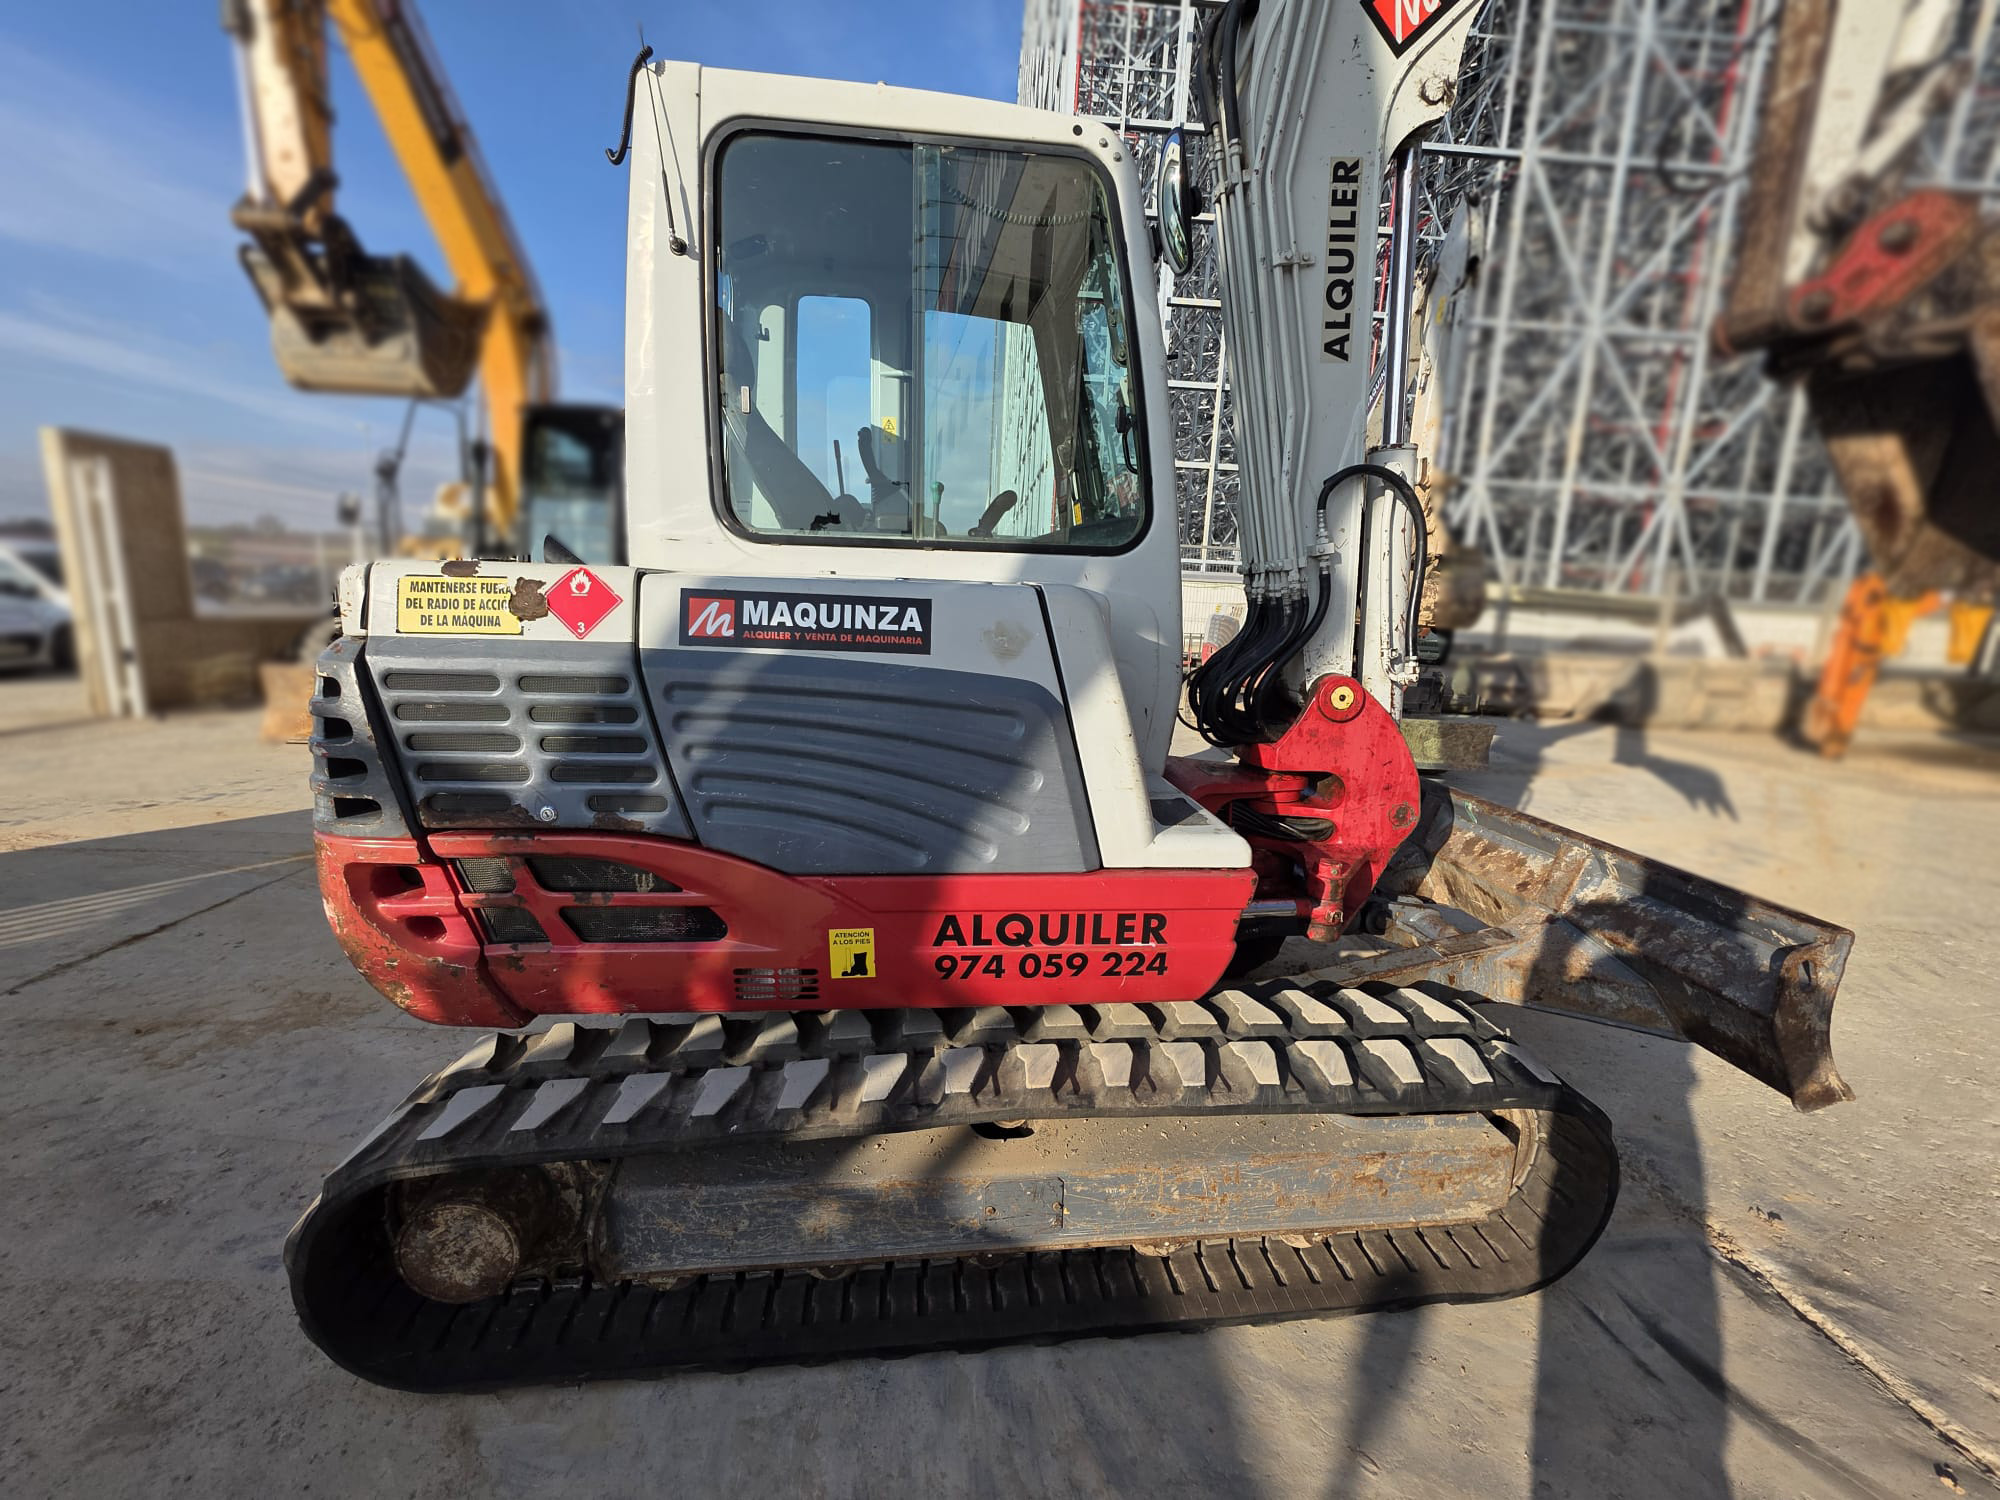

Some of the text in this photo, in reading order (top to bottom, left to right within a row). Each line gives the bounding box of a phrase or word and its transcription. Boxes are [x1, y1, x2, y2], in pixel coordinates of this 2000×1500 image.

[1323, 158, 1360, 362] ALQUILER
[410, 581, 477, 594] MANTENERSE
[406, 596, 509, 611] DEL RADIO DE ACCIÓ
[420, 612, 502, 628] DE LA MÁQUINA
[742, 600, 923, 632] MAQUINZA
[577, 621, 586, 633] 3
[742, 630, 923, 645] ALQUILER Y VENTA DE MAQUINARIA
[932, 913, 1167, 947] ALQUILER
[934, 951, 1168, 980] 974 059 224
